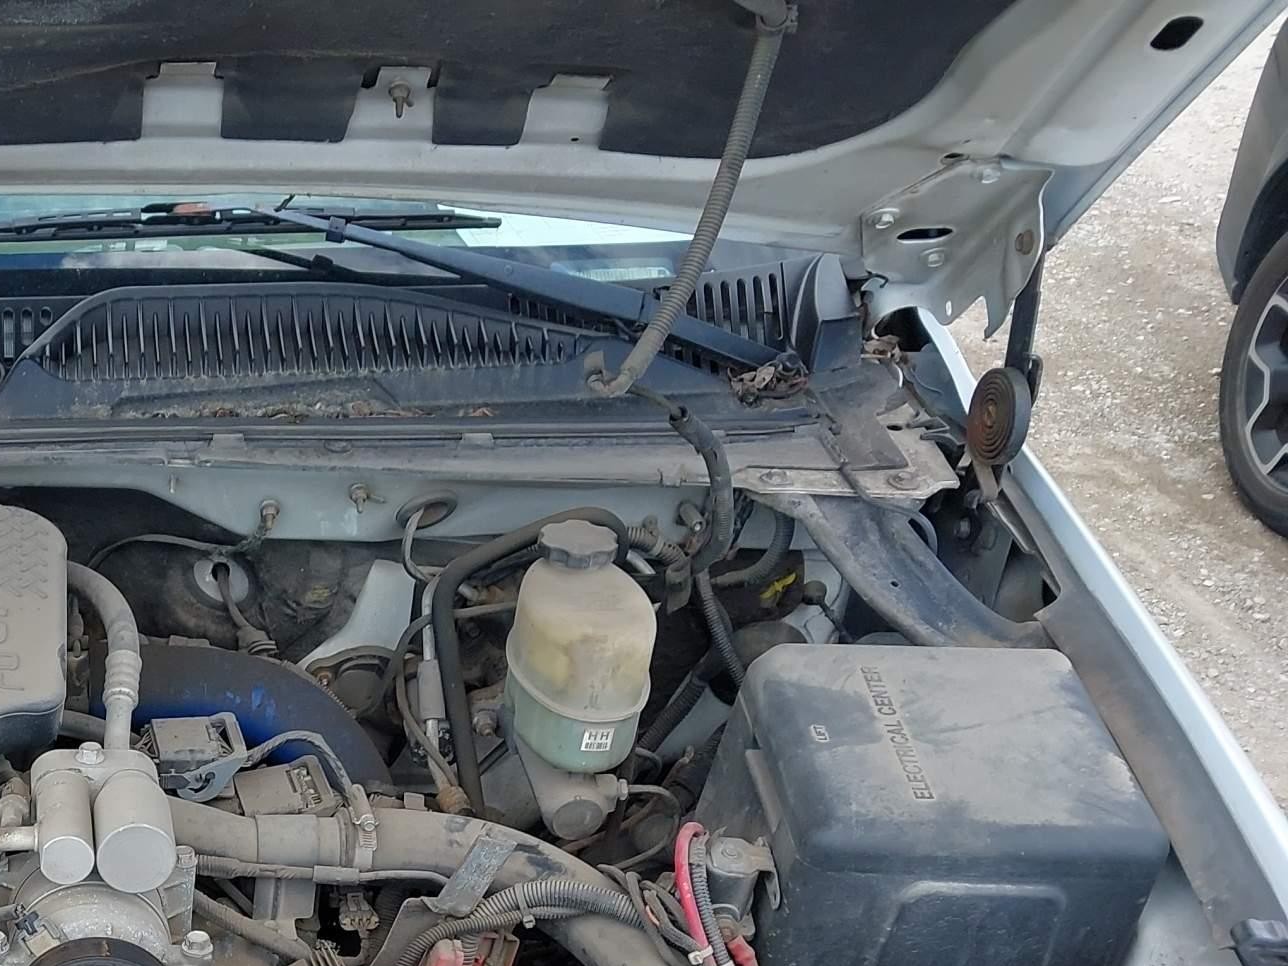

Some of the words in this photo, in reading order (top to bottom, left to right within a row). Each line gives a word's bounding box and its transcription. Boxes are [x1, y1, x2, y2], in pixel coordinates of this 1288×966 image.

[860, 665, 897, 717] CENTER
[813, 725, 828, 741] LIFT
[884, 719, 935, 800] ELECTRICAL
